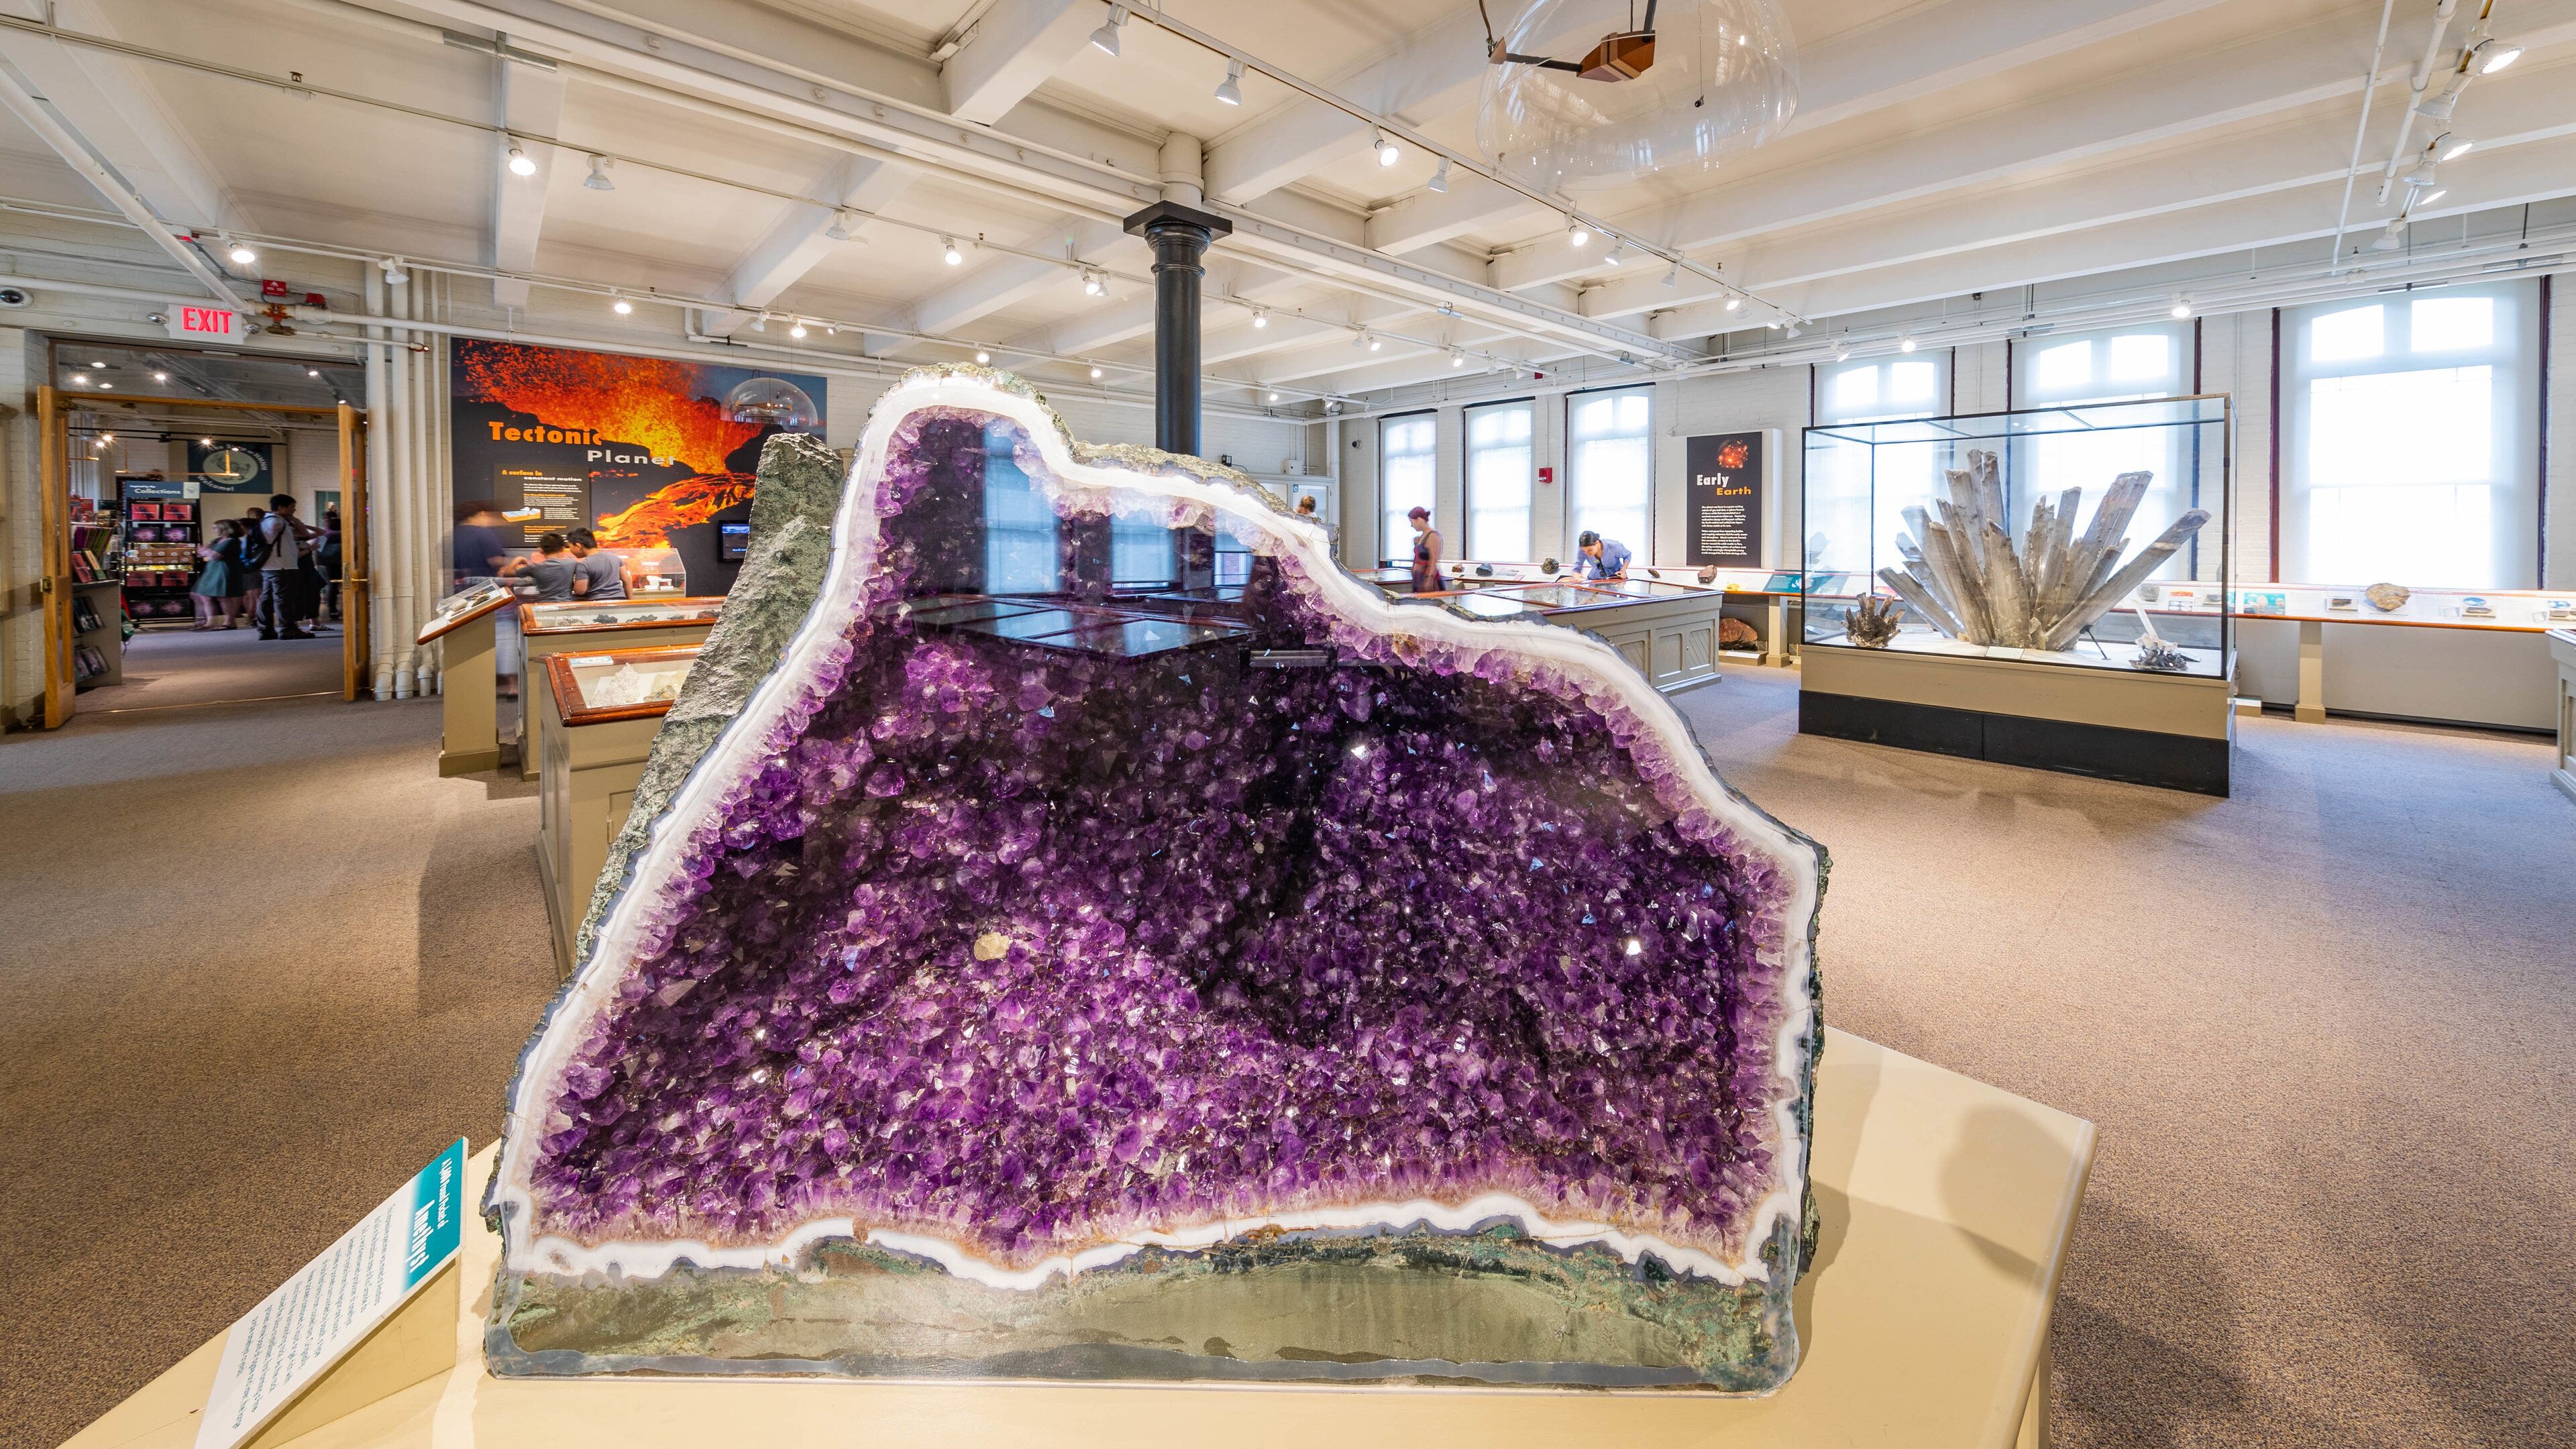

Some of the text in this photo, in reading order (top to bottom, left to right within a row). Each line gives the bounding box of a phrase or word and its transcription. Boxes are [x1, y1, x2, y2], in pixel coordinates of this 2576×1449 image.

[182, 307, 233, 333] EXIT
[488, 421, 603, 446] Tectonic
[587, 449, 676, 466] Planet
[197, 475, 235, 492] Welcome!
[1697, 472, 1729, 488] Early
[1717, 486, 1752, 496] Earth
[438, 1182, 450, 1201] Pound
[437, 1199, 449, 1222] Pocket
[436, 1220, 448, 1230] of
[405, 1199, 435, 1273] Amethyst
